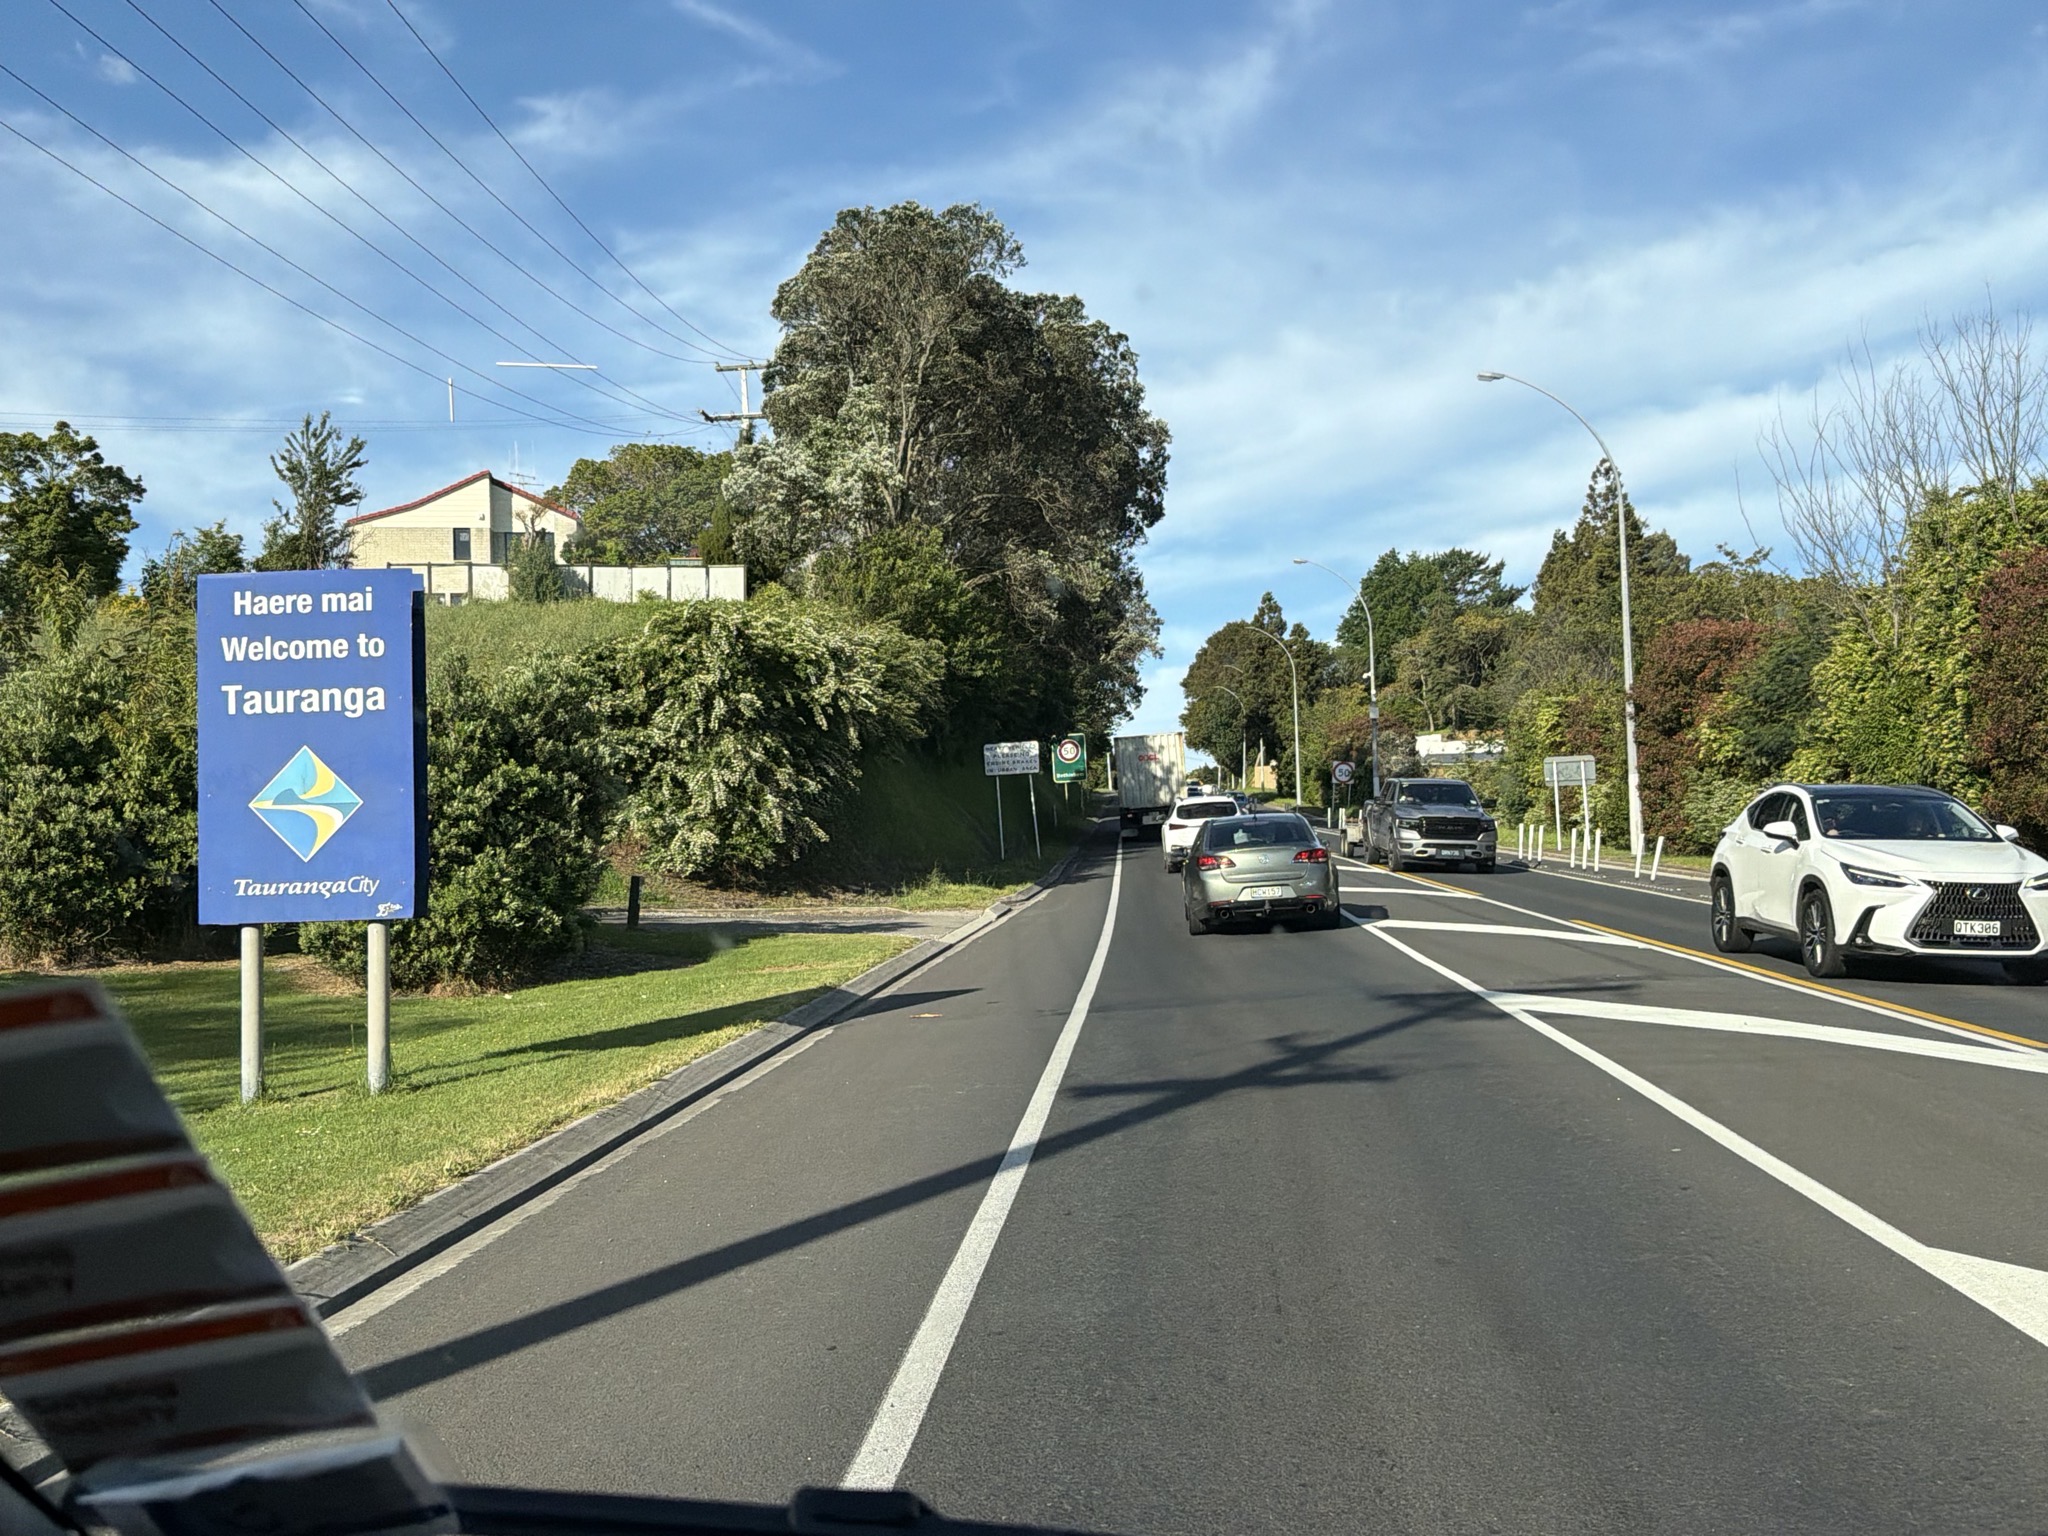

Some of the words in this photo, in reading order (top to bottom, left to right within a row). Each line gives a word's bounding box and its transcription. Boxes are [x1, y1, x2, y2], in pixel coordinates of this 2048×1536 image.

[233, 590, 313, 616] Haere
[321, 586, 373, 612] mai
[221, 635, 349, 662] Welcome
[357, 633, 386, 658] to
[221, 684, 386, 718] Tauranga
[1063, 746, 1076, 756] 50
[986, 759, 1010, 767] ENGINE
[1338, 768, 1350, 777] 50
[1252, 887, 1280, 896] HCW157
[1955, 922, 1999, 934] QTK306
